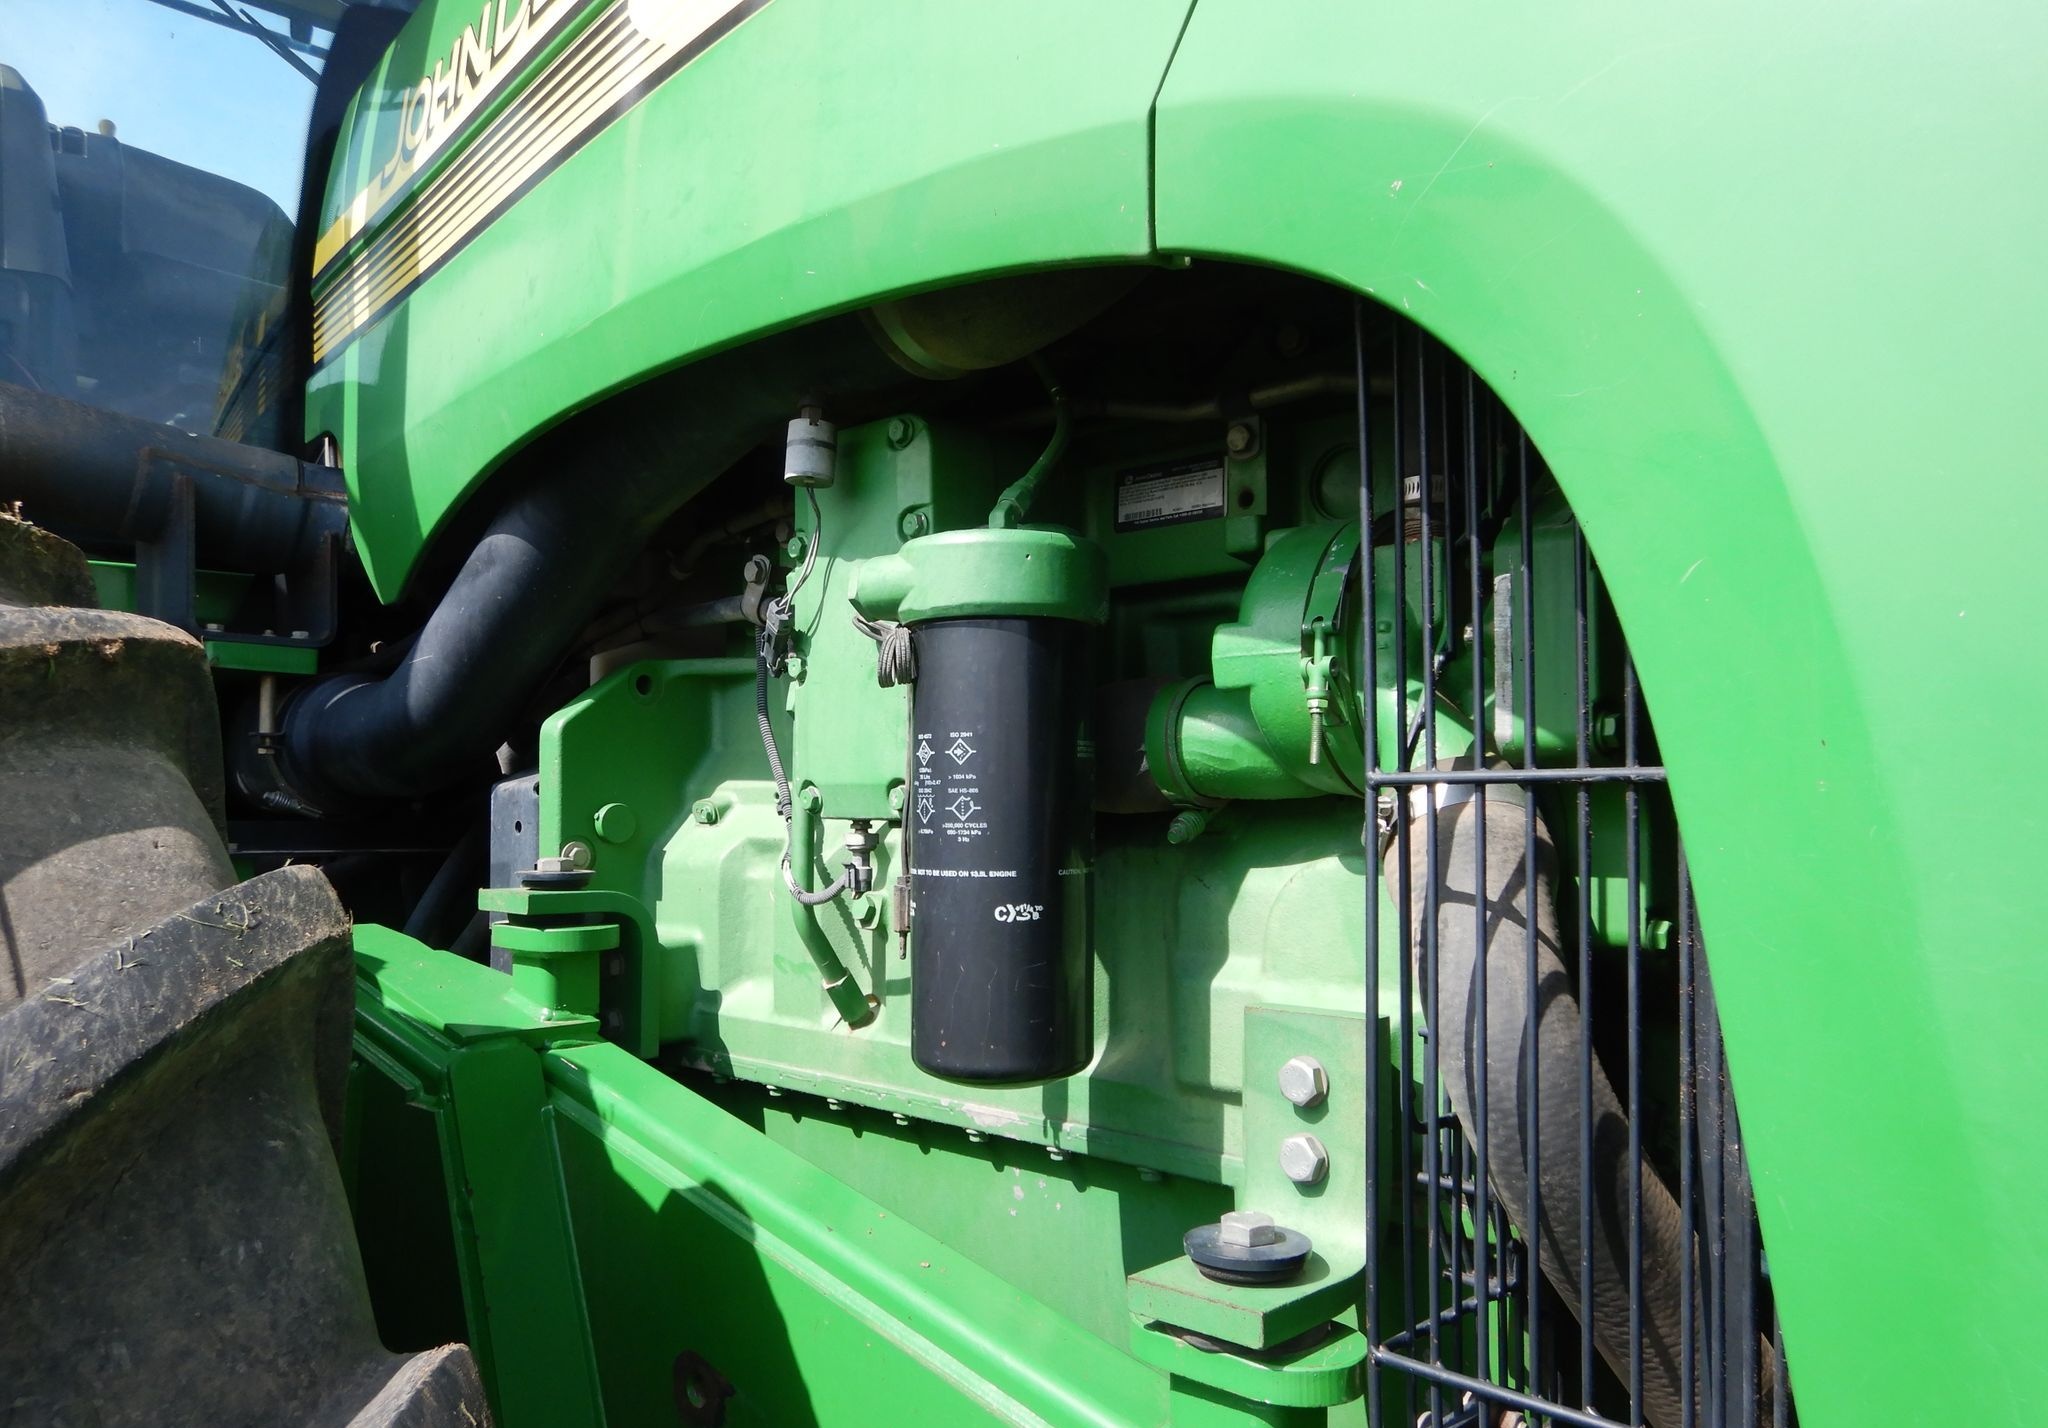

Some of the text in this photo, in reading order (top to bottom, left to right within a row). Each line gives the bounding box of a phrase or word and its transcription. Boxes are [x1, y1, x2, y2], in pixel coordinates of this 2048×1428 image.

[382, 0, 492, 186] JOHN
[940, 869, 957, 877] USED
[989, 870, 1017, 878] ENGINE
